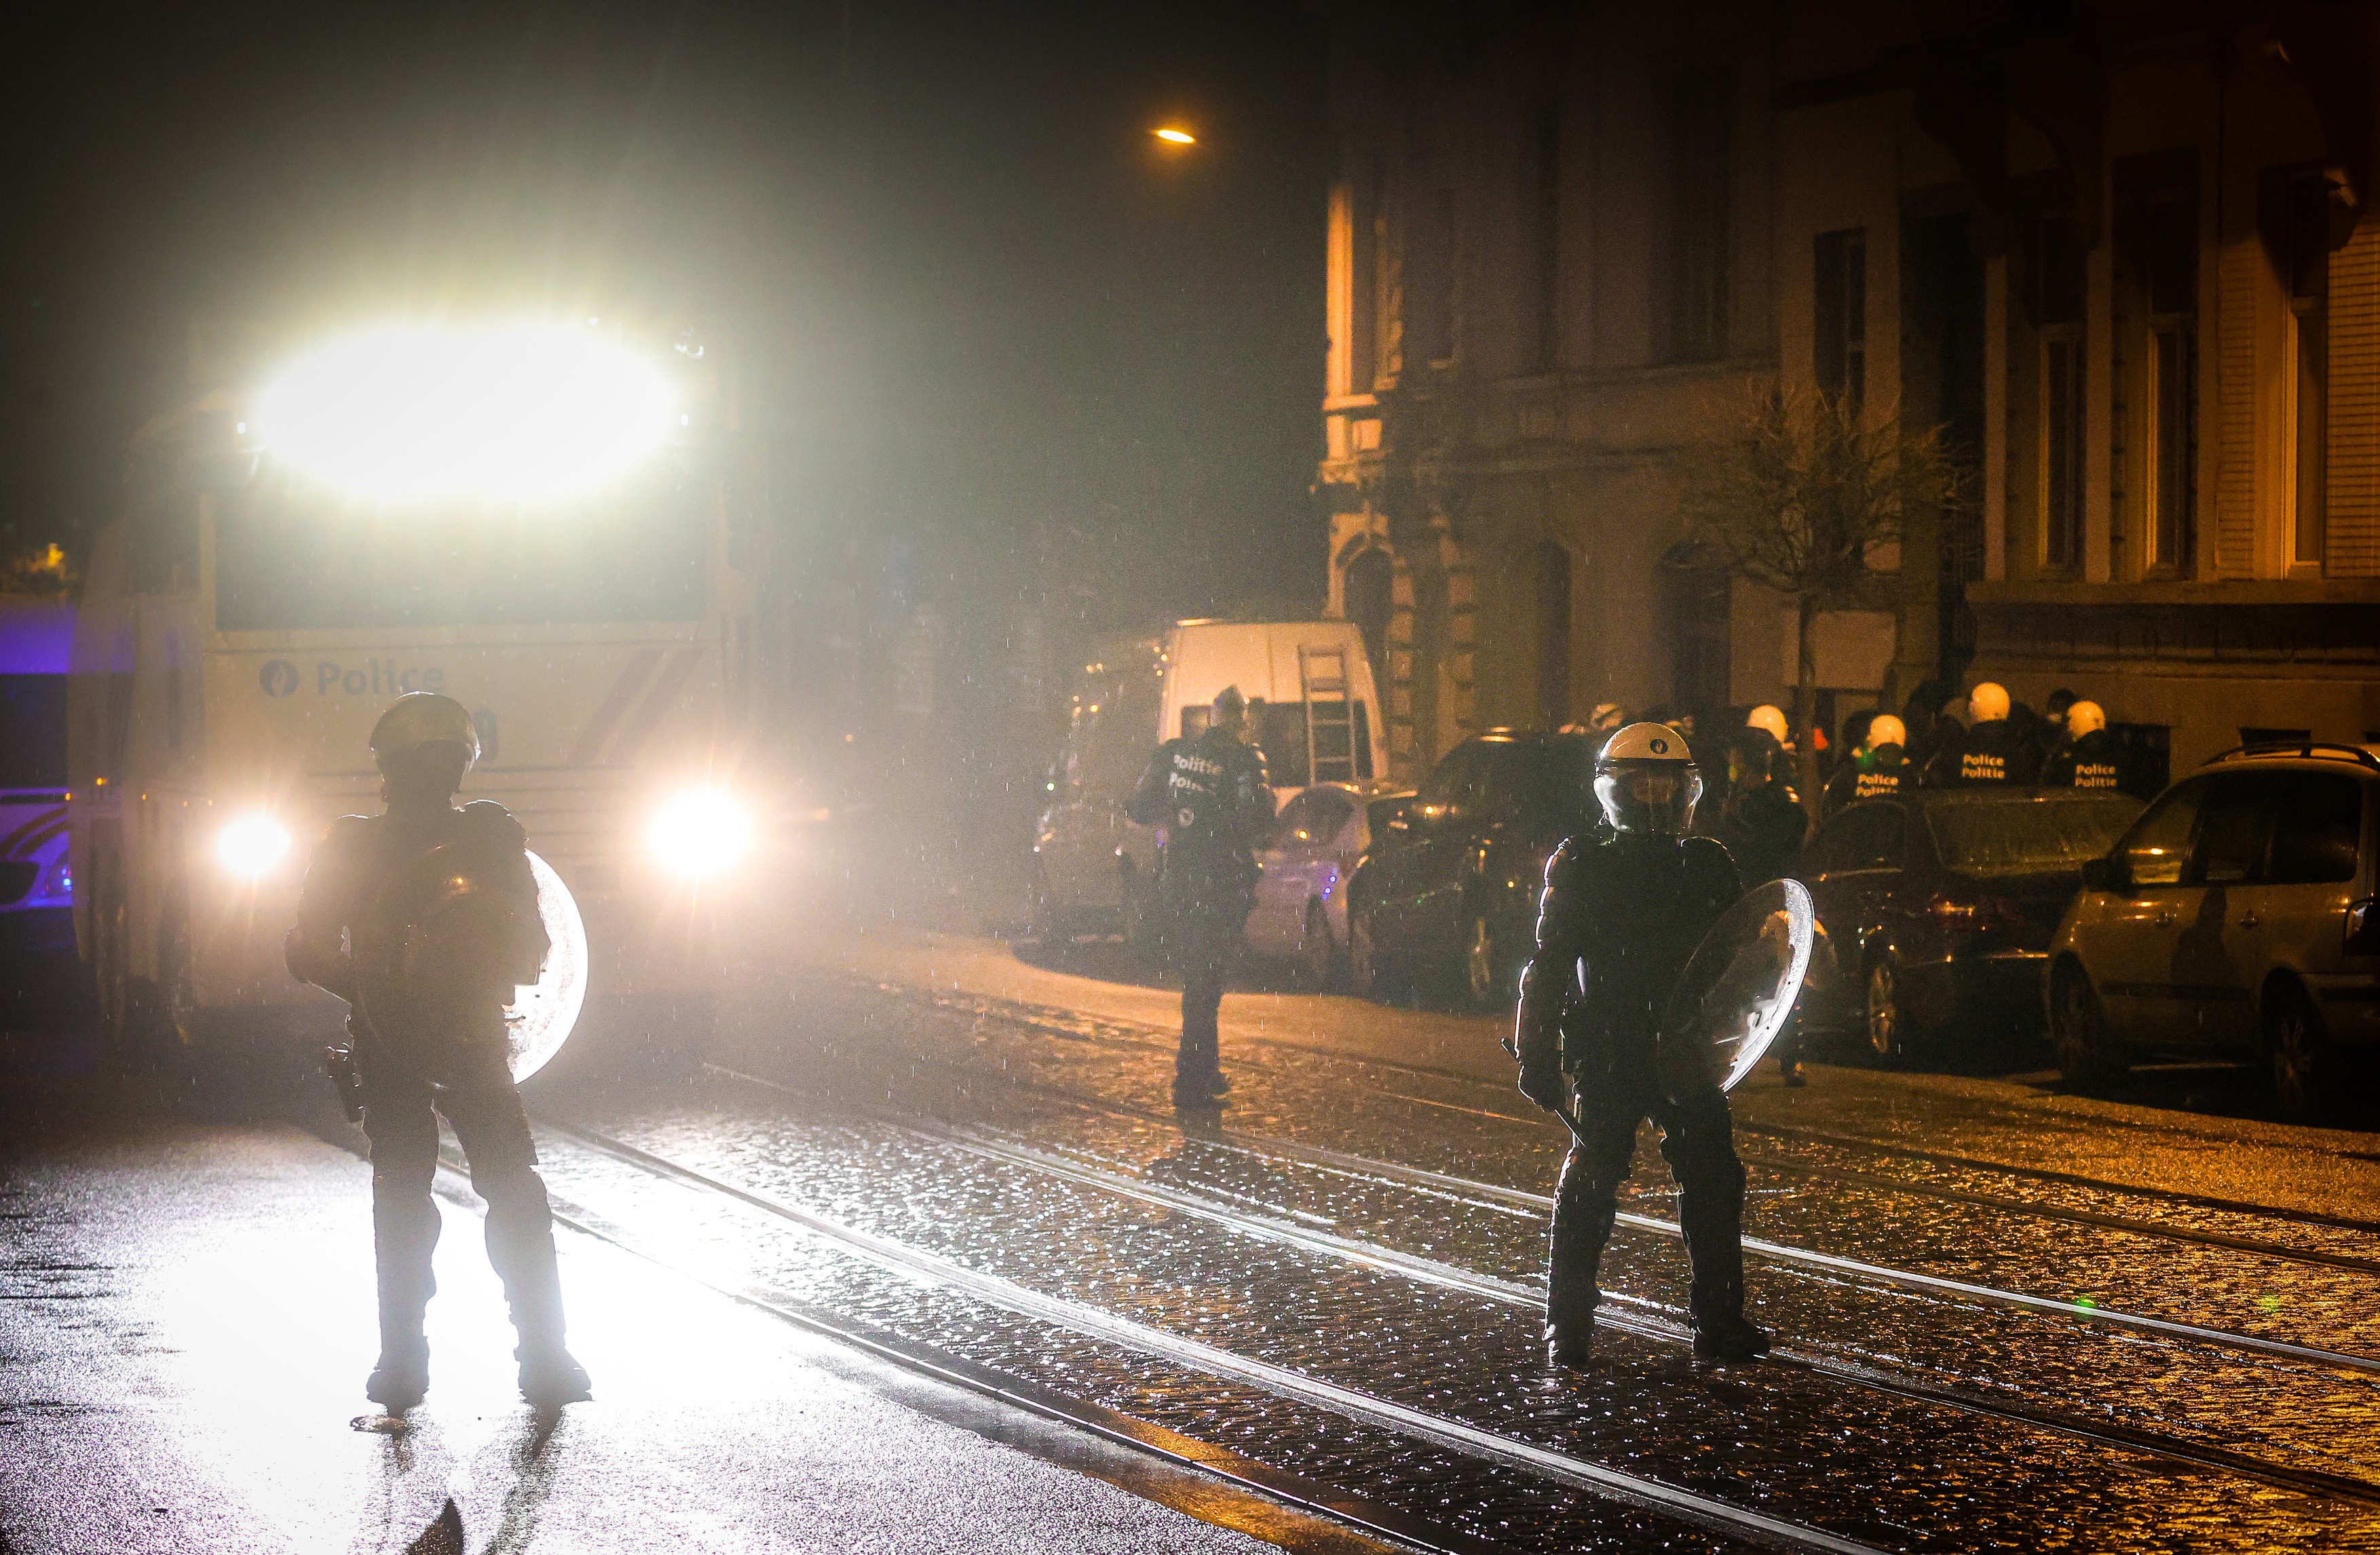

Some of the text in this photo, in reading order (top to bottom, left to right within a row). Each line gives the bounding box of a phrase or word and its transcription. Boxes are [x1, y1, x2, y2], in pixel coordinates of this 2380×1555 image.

[317, 658, 445, 695] Police
[1963, 754, 2005, 767] Police
[1962, 767, 2005, 779] Politie
[2076, 763, 2117, 775] Police
[1858, 773, 1898, 786] Police
[2075, 777, 2117, 787] Politie
